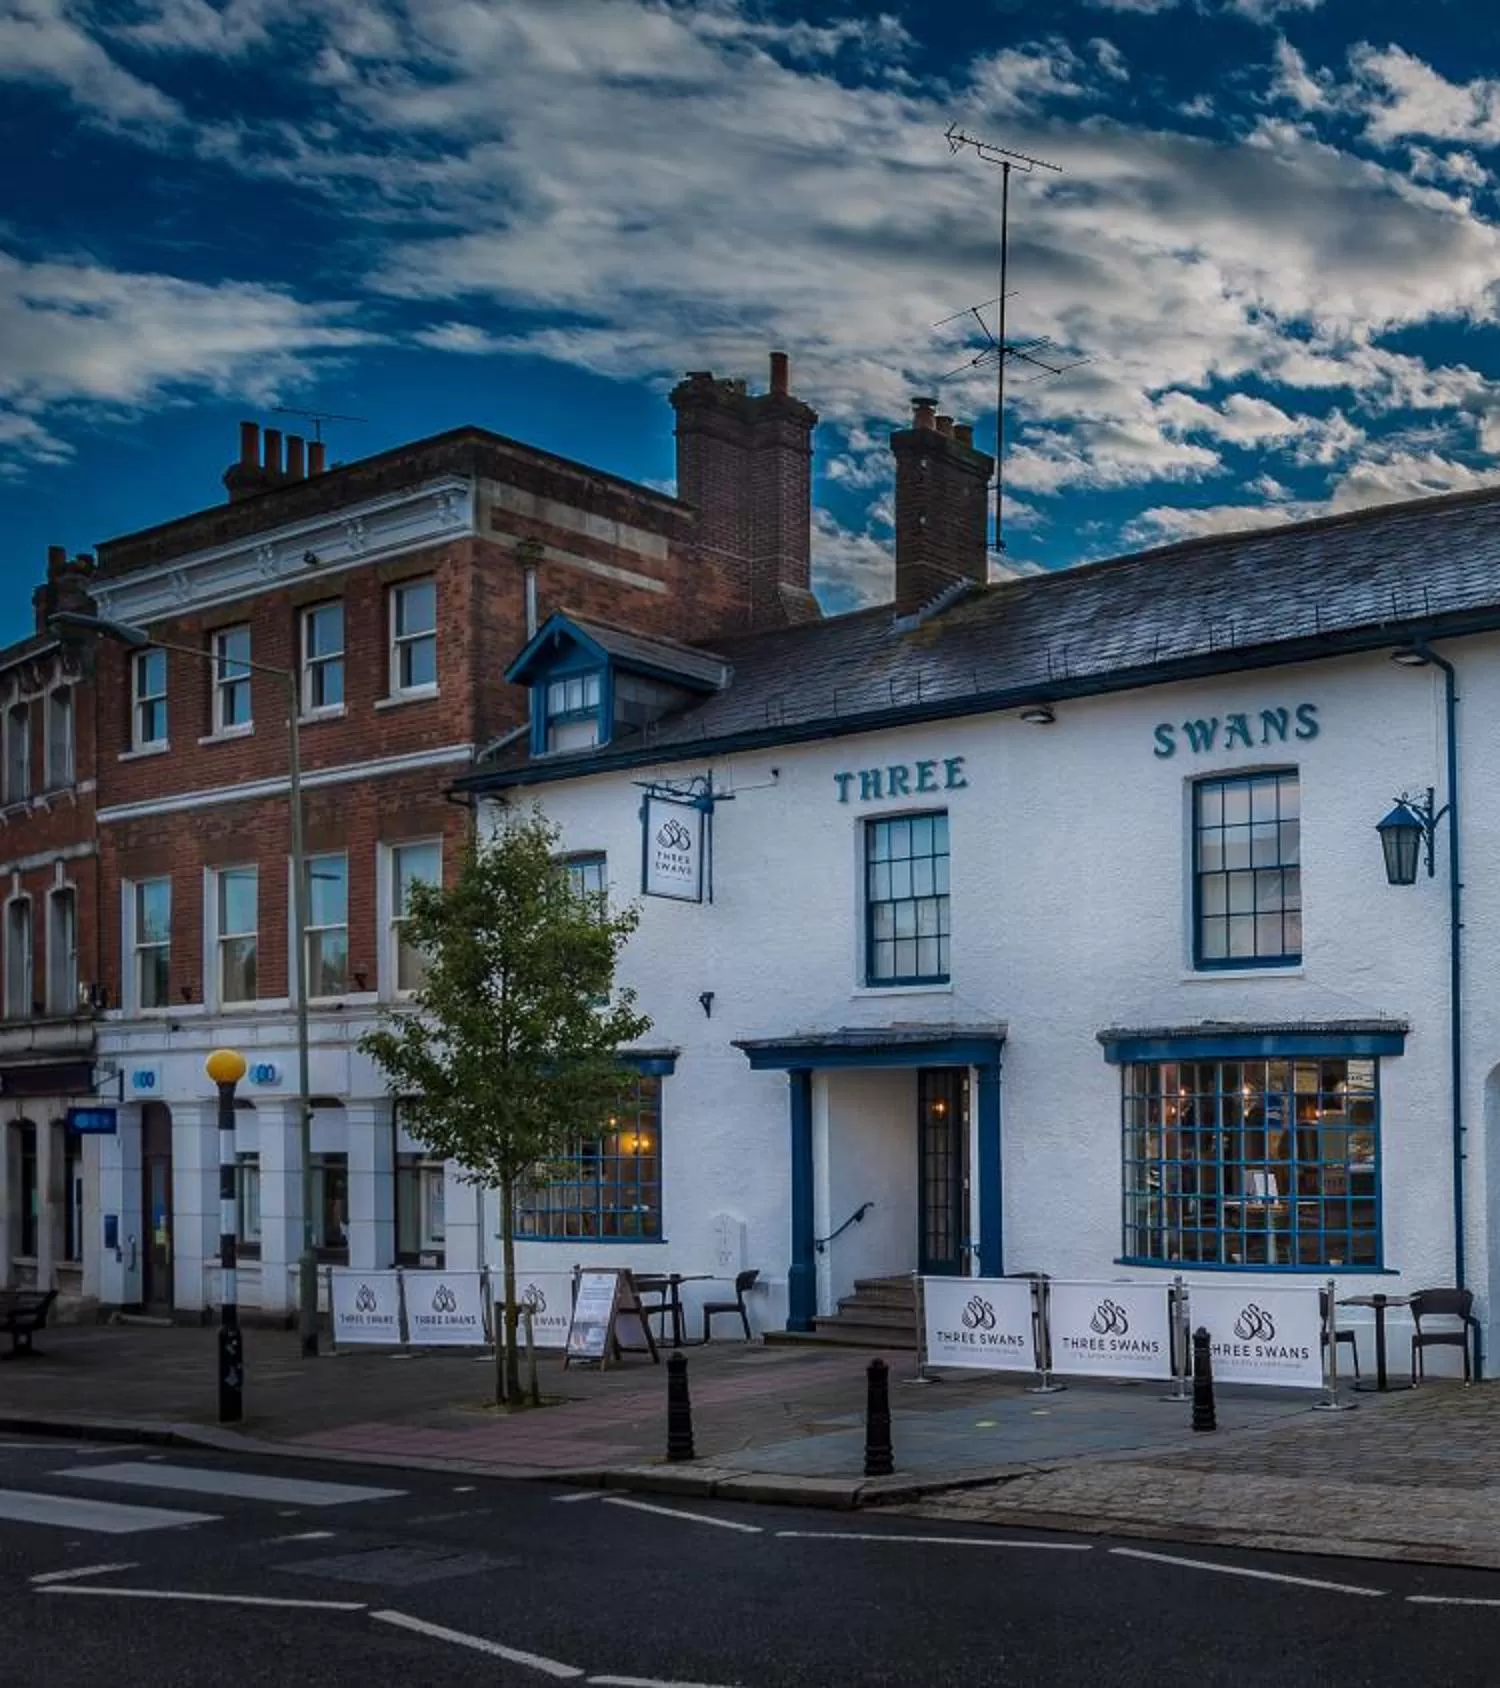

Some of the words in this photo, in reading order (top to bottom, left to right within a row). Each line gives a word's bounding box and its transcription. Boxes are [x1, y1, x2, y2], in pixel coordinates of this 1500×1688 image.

[834, 756, 969, 803] THREE
[1153, 703, 1320, 759] SWANS
[657, 851, 690, 864] THREE
[656, 861, 691, 875] SWANS
[415, 1315, 443, 1325] THREE
[936, 1331, 977, 1344] THREE
[980, 1333, 1025, 1347] SWANS
[1062, 1337, 1105, 1351] THREE
[1110, 1339, 1159, 1352] SWANS
[1211, 1343, 1251, 1356] HREE
[1255, 1345, 1309, 1359] SWANS
